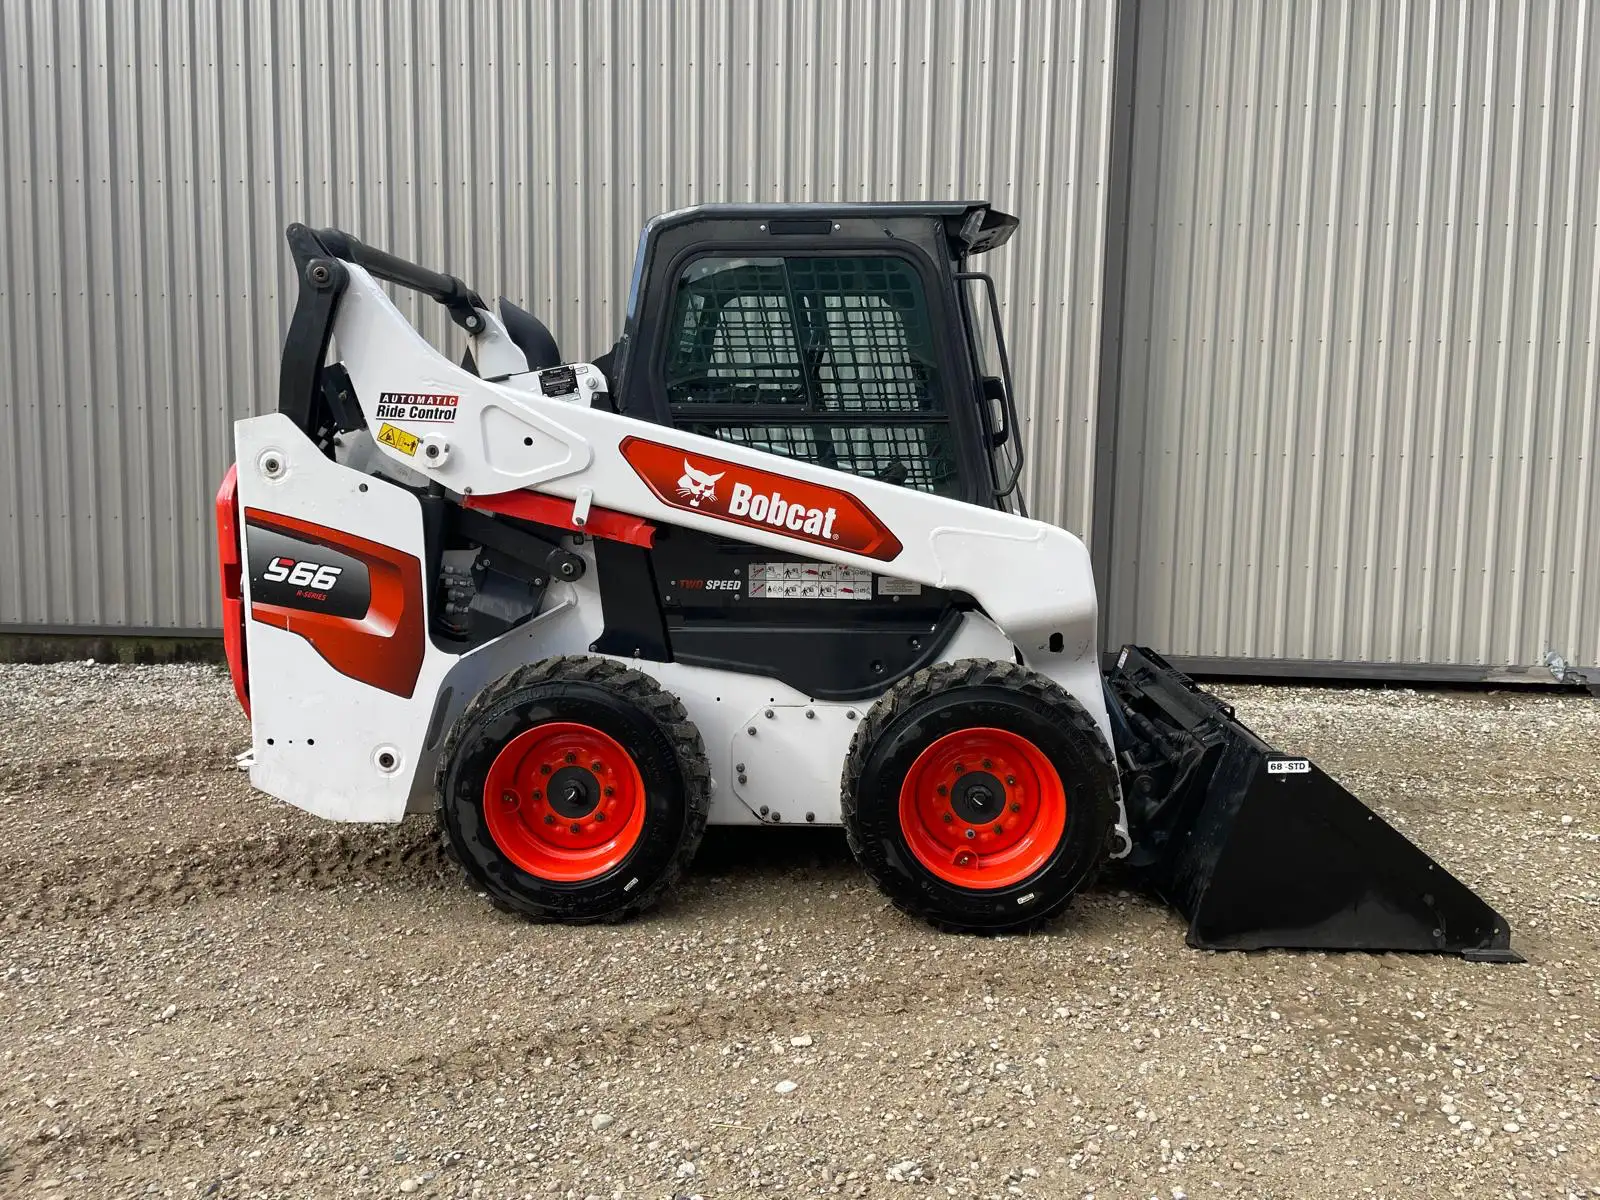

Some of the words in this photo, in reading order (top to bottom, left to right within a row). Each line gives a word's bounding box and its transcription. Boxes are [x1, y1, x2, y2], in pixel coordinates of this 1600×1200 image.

[382, 394, 457, 406] AUTOMATIC
[376, 404, 406, 418] Ride
[409, 405, 457, 420] Control
[728, 482, 837, 540] Bobcat
[263, 557, 343, 590] S66
[678, 579, 704, 590] TWO
[705, 580, 742, 590] SPEED
[296, 590, 328, 601] R-SERIES
